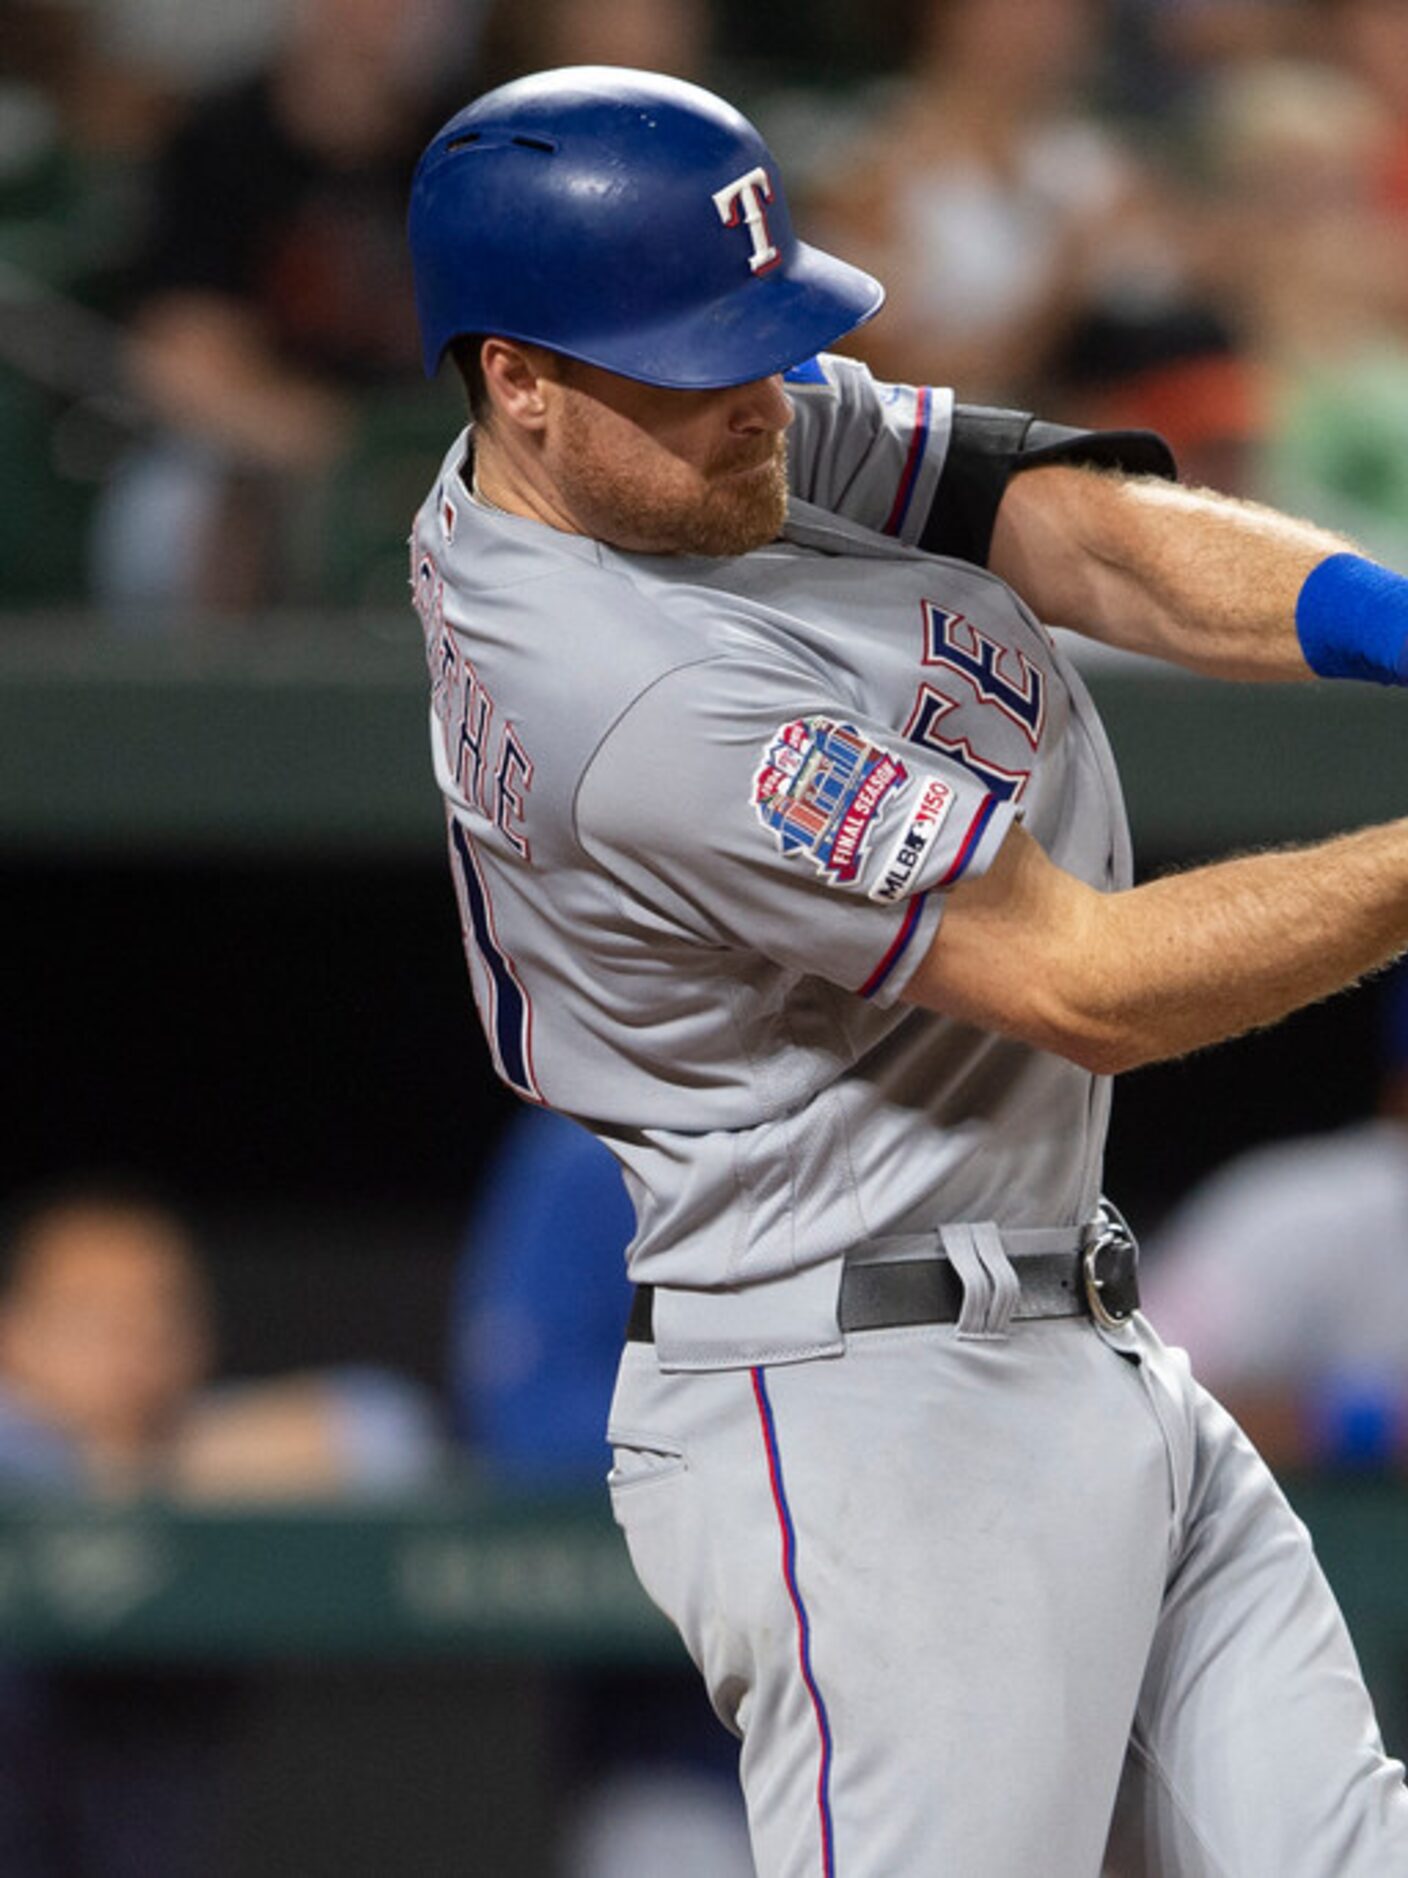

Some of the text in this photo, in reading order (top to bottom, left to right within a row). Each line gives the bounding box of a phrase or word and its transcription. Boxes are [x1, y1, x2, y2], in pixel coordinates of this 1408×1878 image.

[712, 167, 781, 276] T
[832, 760, 897, 866] FINAL SEASON
[878, 782, 949, 899] MLB 150
